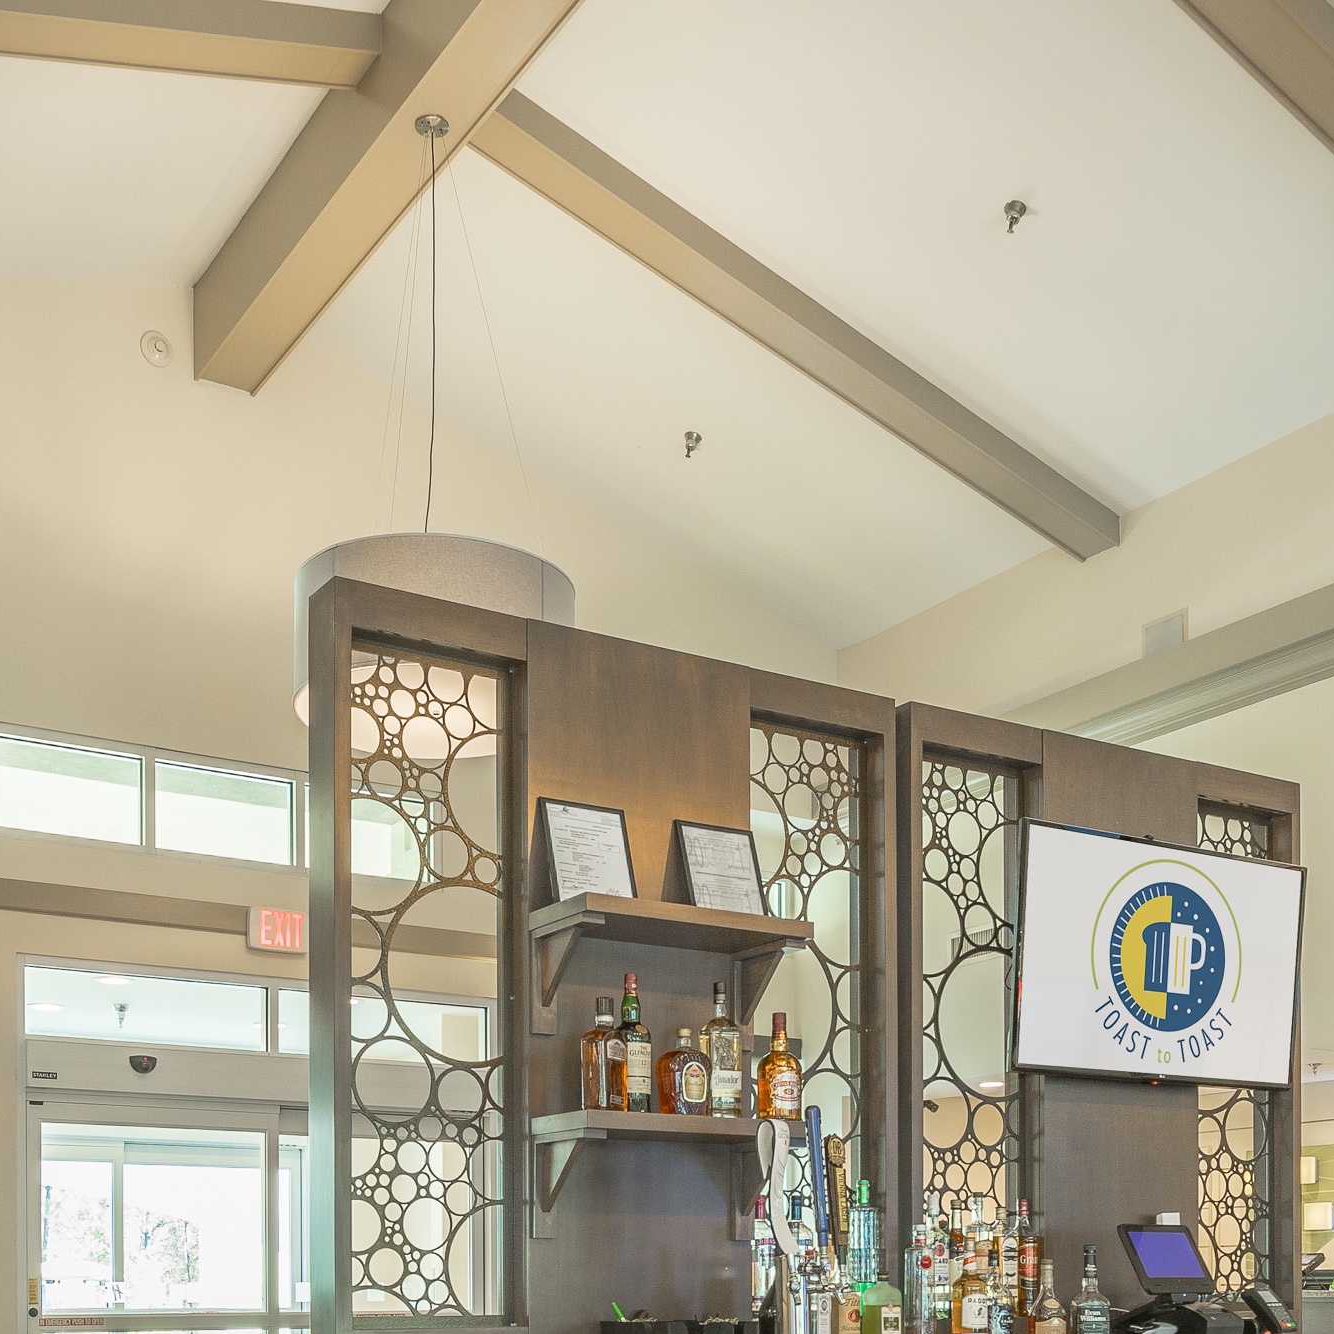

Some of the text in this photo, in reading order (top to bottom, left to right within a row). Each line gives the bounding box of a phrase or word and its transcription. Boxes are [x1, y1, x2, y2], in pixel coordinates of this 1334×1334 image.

[259, 909, 305, 950] EXIT
[1095, 996, 1232, 1064] TOAST to TOAST
[838, 1173, 846, 1199] VIENNA
[46, 1318, 72, 1326] EMERGENCY
[72, 1318, 84, 1326] PUSH
